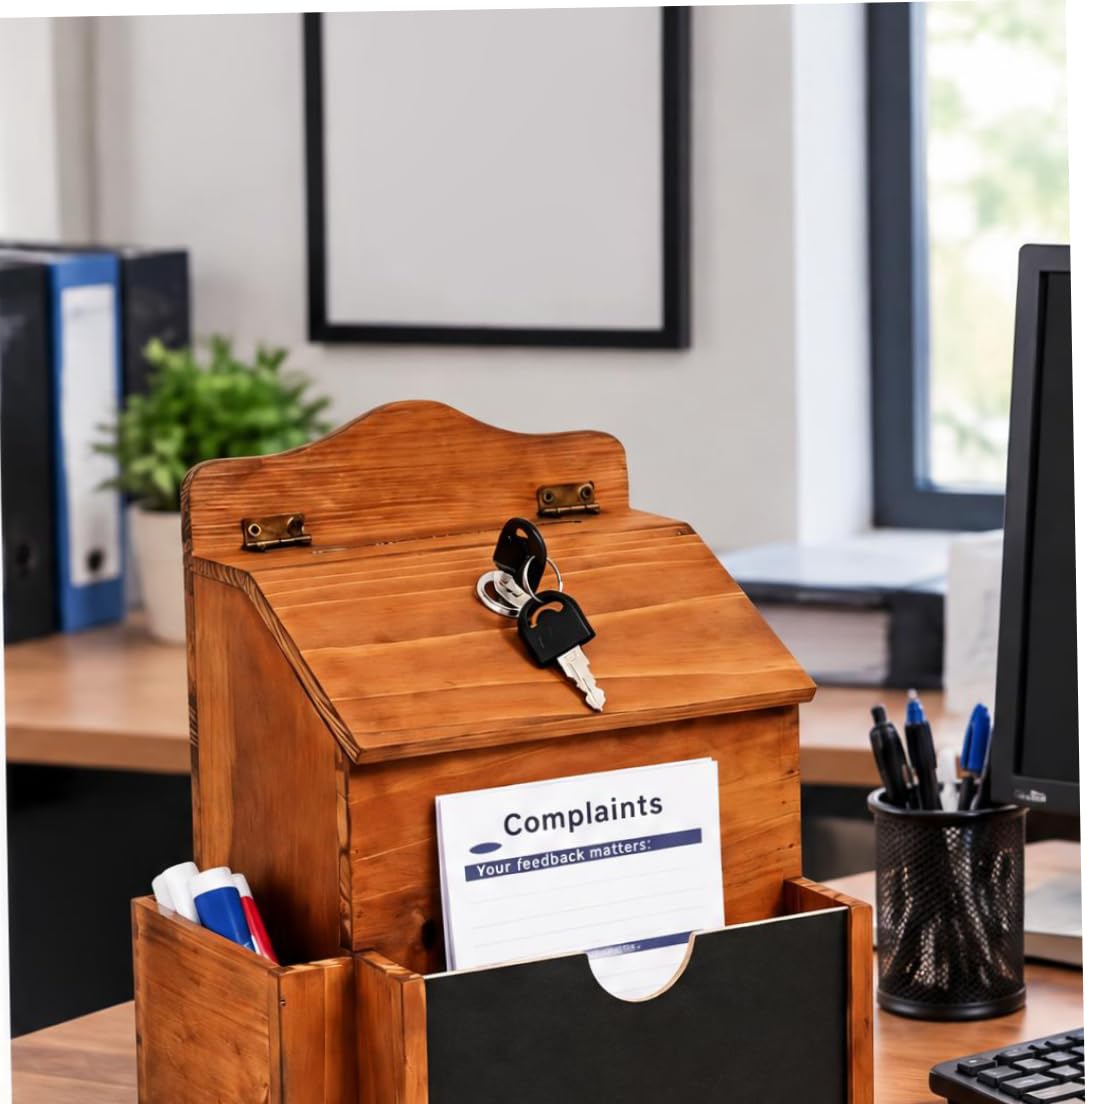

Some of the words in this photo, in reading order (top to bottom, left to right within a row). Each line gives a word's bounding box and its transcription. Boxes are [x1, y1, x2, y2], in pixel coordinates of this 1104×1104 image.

[503, 794, 663, 836] Complaints
[476, 862, 511, 878] Your
[517, 848, 585, 872] feedback
[589, 838, 652, 859] matters:
